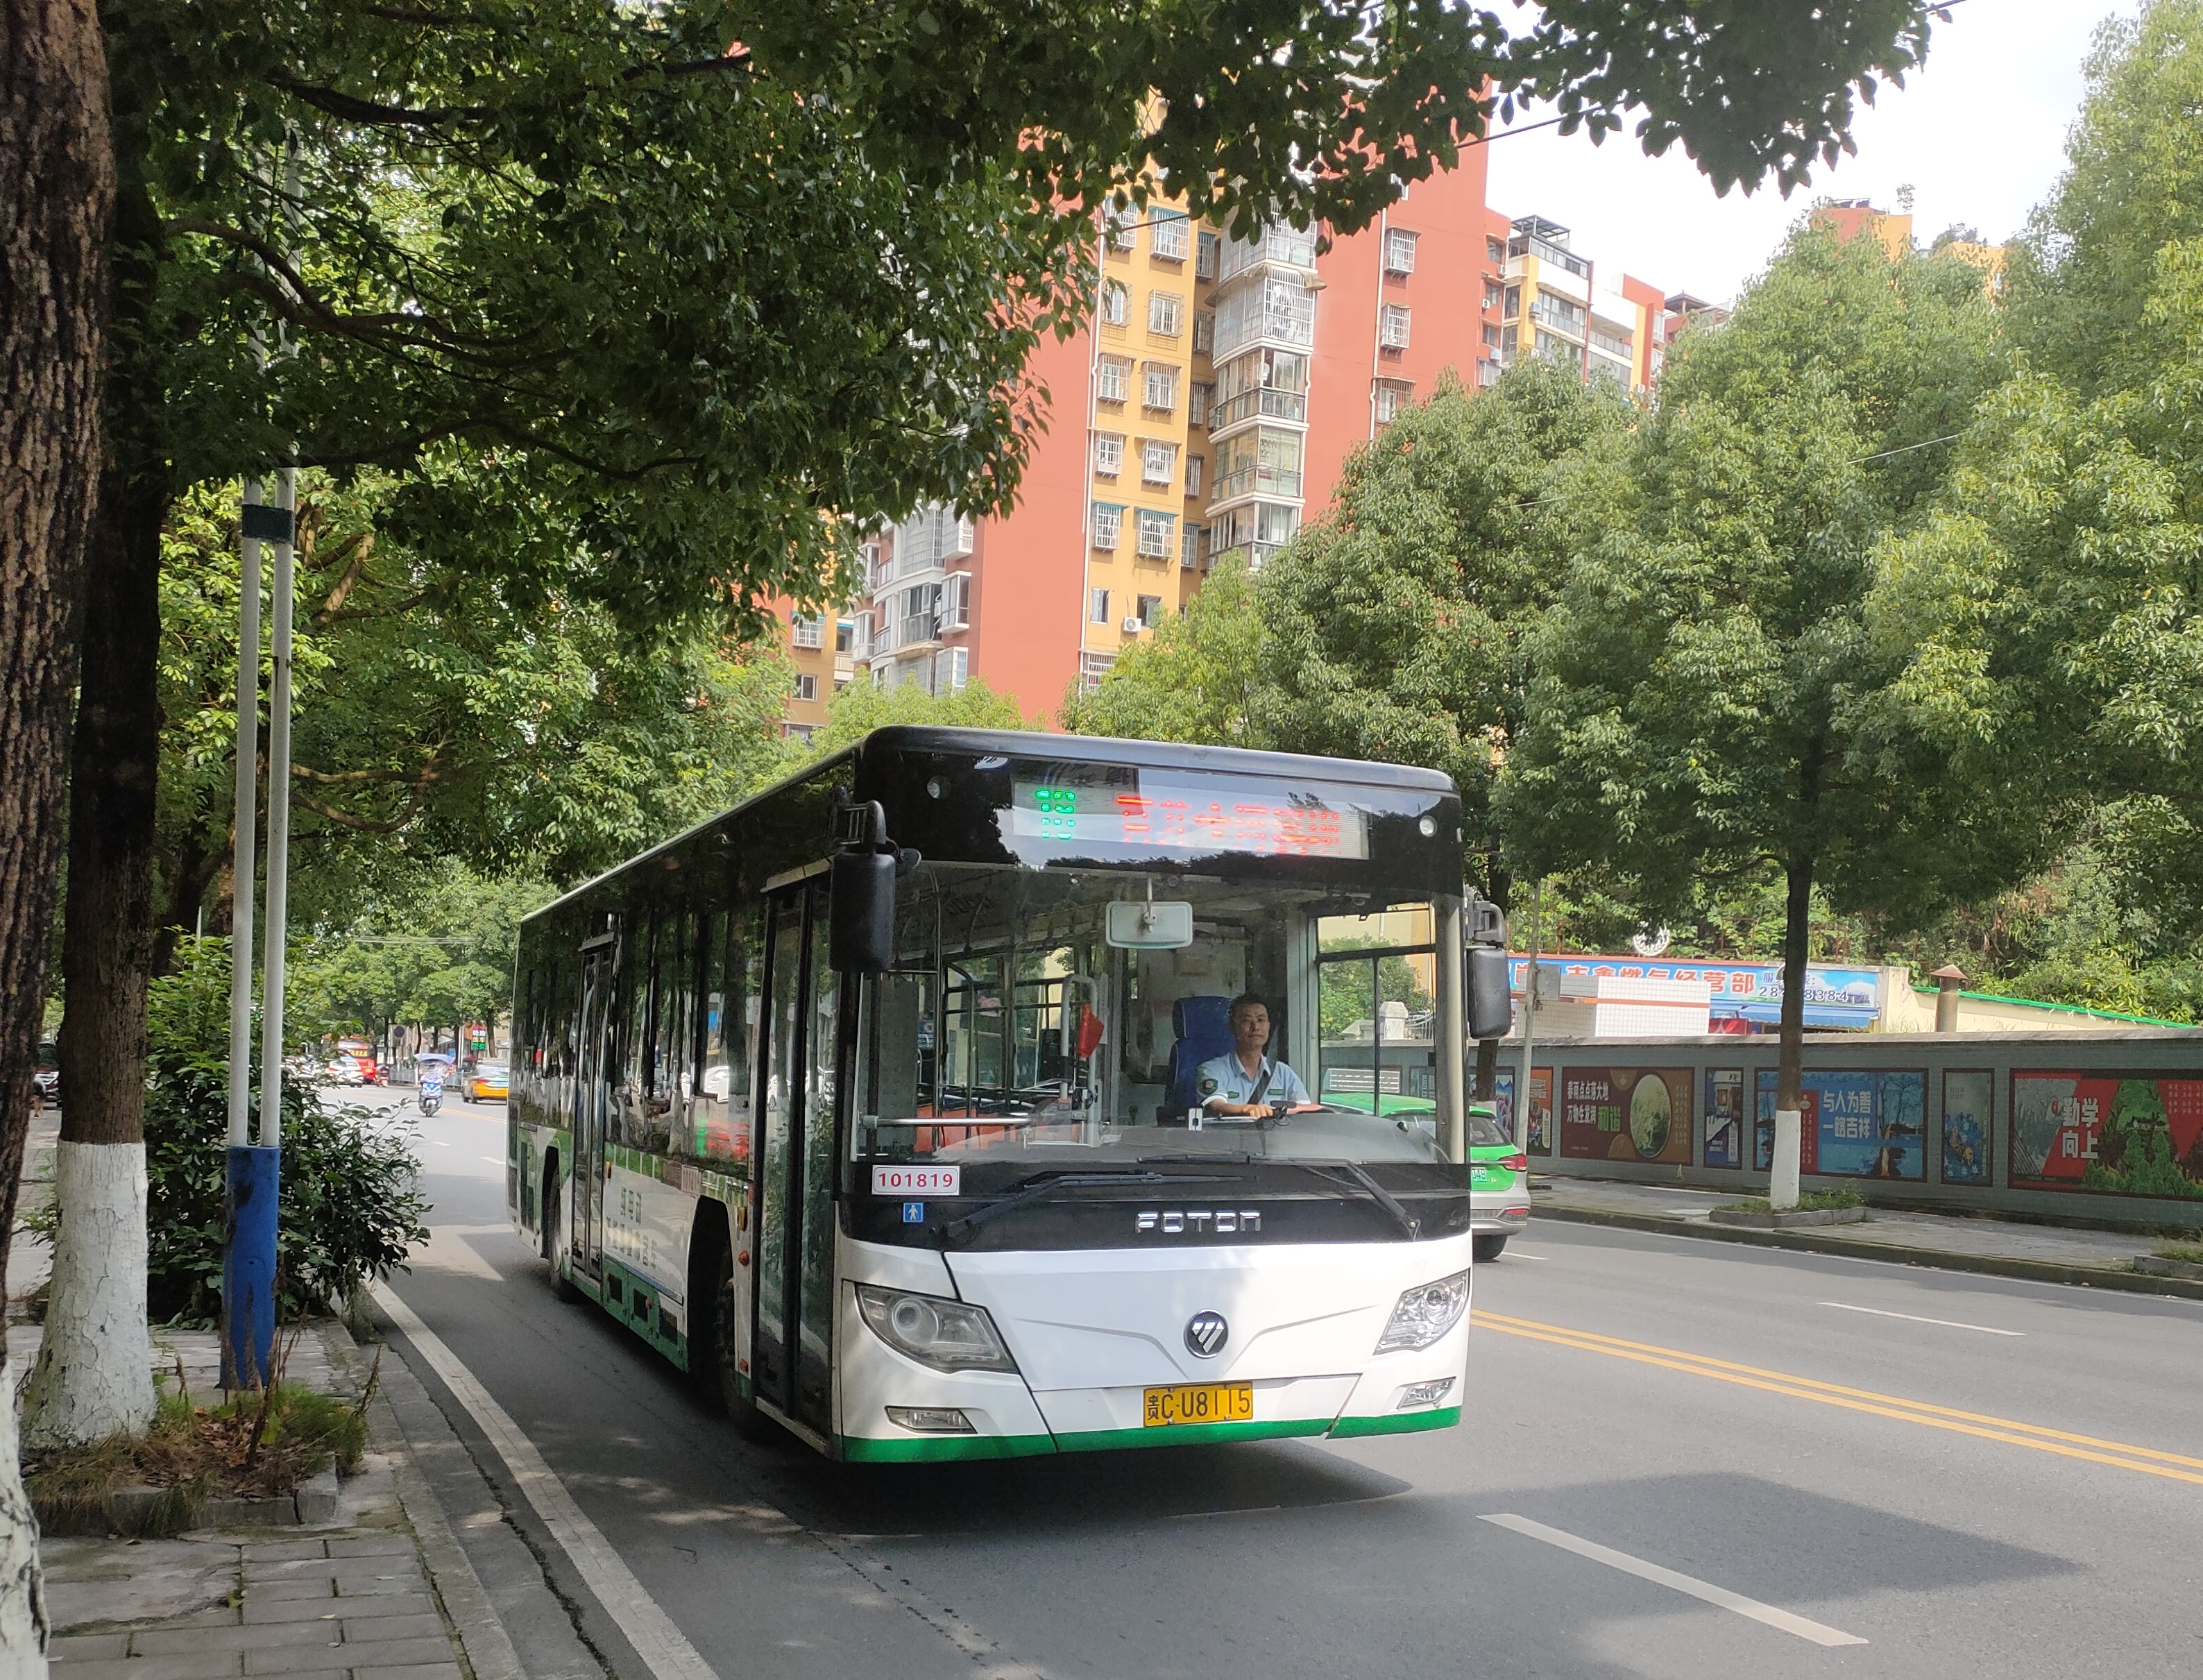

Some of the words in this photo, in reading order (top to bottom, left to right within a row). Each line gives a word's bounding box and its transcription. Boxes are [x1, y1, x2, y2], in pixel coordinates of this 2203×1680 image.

[1759, 986, 1849, 1003] 288384
[1822, 1089, 1871, 1114] 与人为善
[2061, 1096, 2100, 1128] 勤学
[1822, 1116, 1871, 1139] 一路吉祥
[2061, 1130, 2099, 1160] 向上
[878, 1173, 953, 1188] 101819
[1135, 1210, 1261, 1233] FOTON
